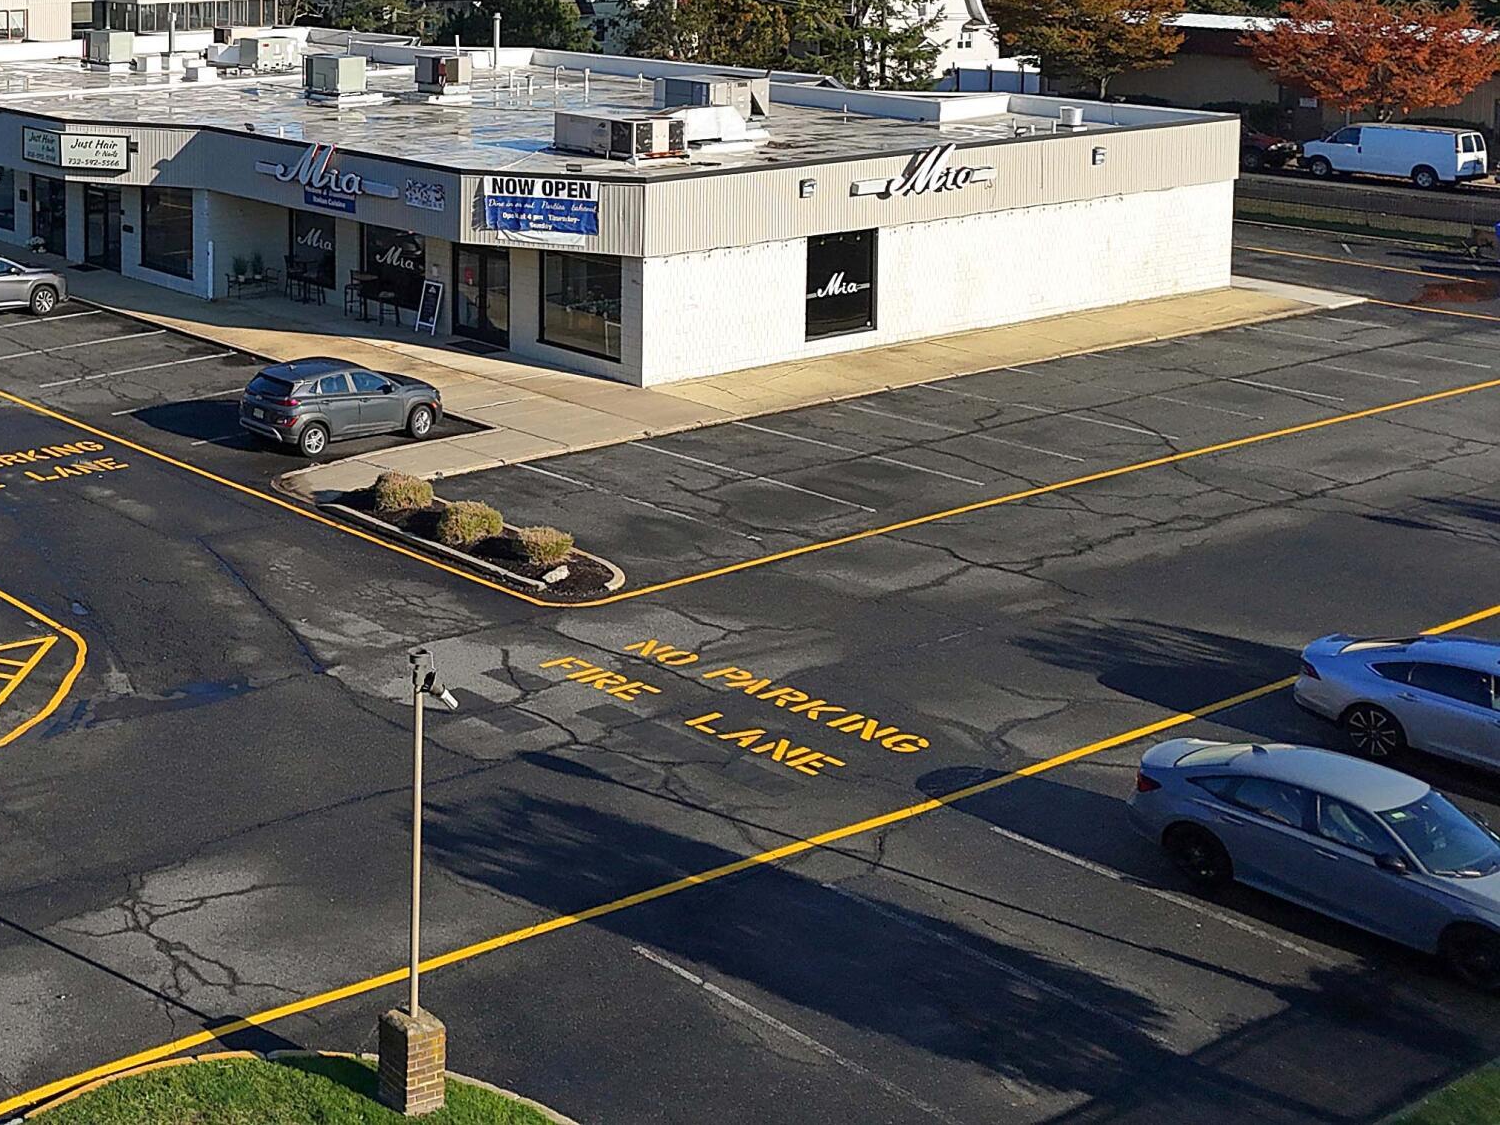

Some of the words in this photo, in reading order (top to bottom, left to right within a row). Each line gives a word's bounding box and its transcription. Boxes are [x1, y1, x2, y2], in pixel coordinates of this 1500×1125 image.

[70, 138, 94, 149] Just
[95, 139, 118, 149] Hair
[276, 142, 364, 195] Mia
[889, 143, 973, 196] Mia
[492, 177, 536, 195] NOW
[541, 180, 592, 199] OPEN
[488, 198, 505, 207] Dine
[297, 227, 333, 251] Mia
[375, 246, 415, 271] Mia
[817, 271, 859, 298] Mia
[24, 457, 130, 483] LANE
[624, 639, 700, 667] NO
[702, 666, 931, 754] PARKING
[539, 656, 663, 702] FIRE
[684, 712, 847, 777] LANE
